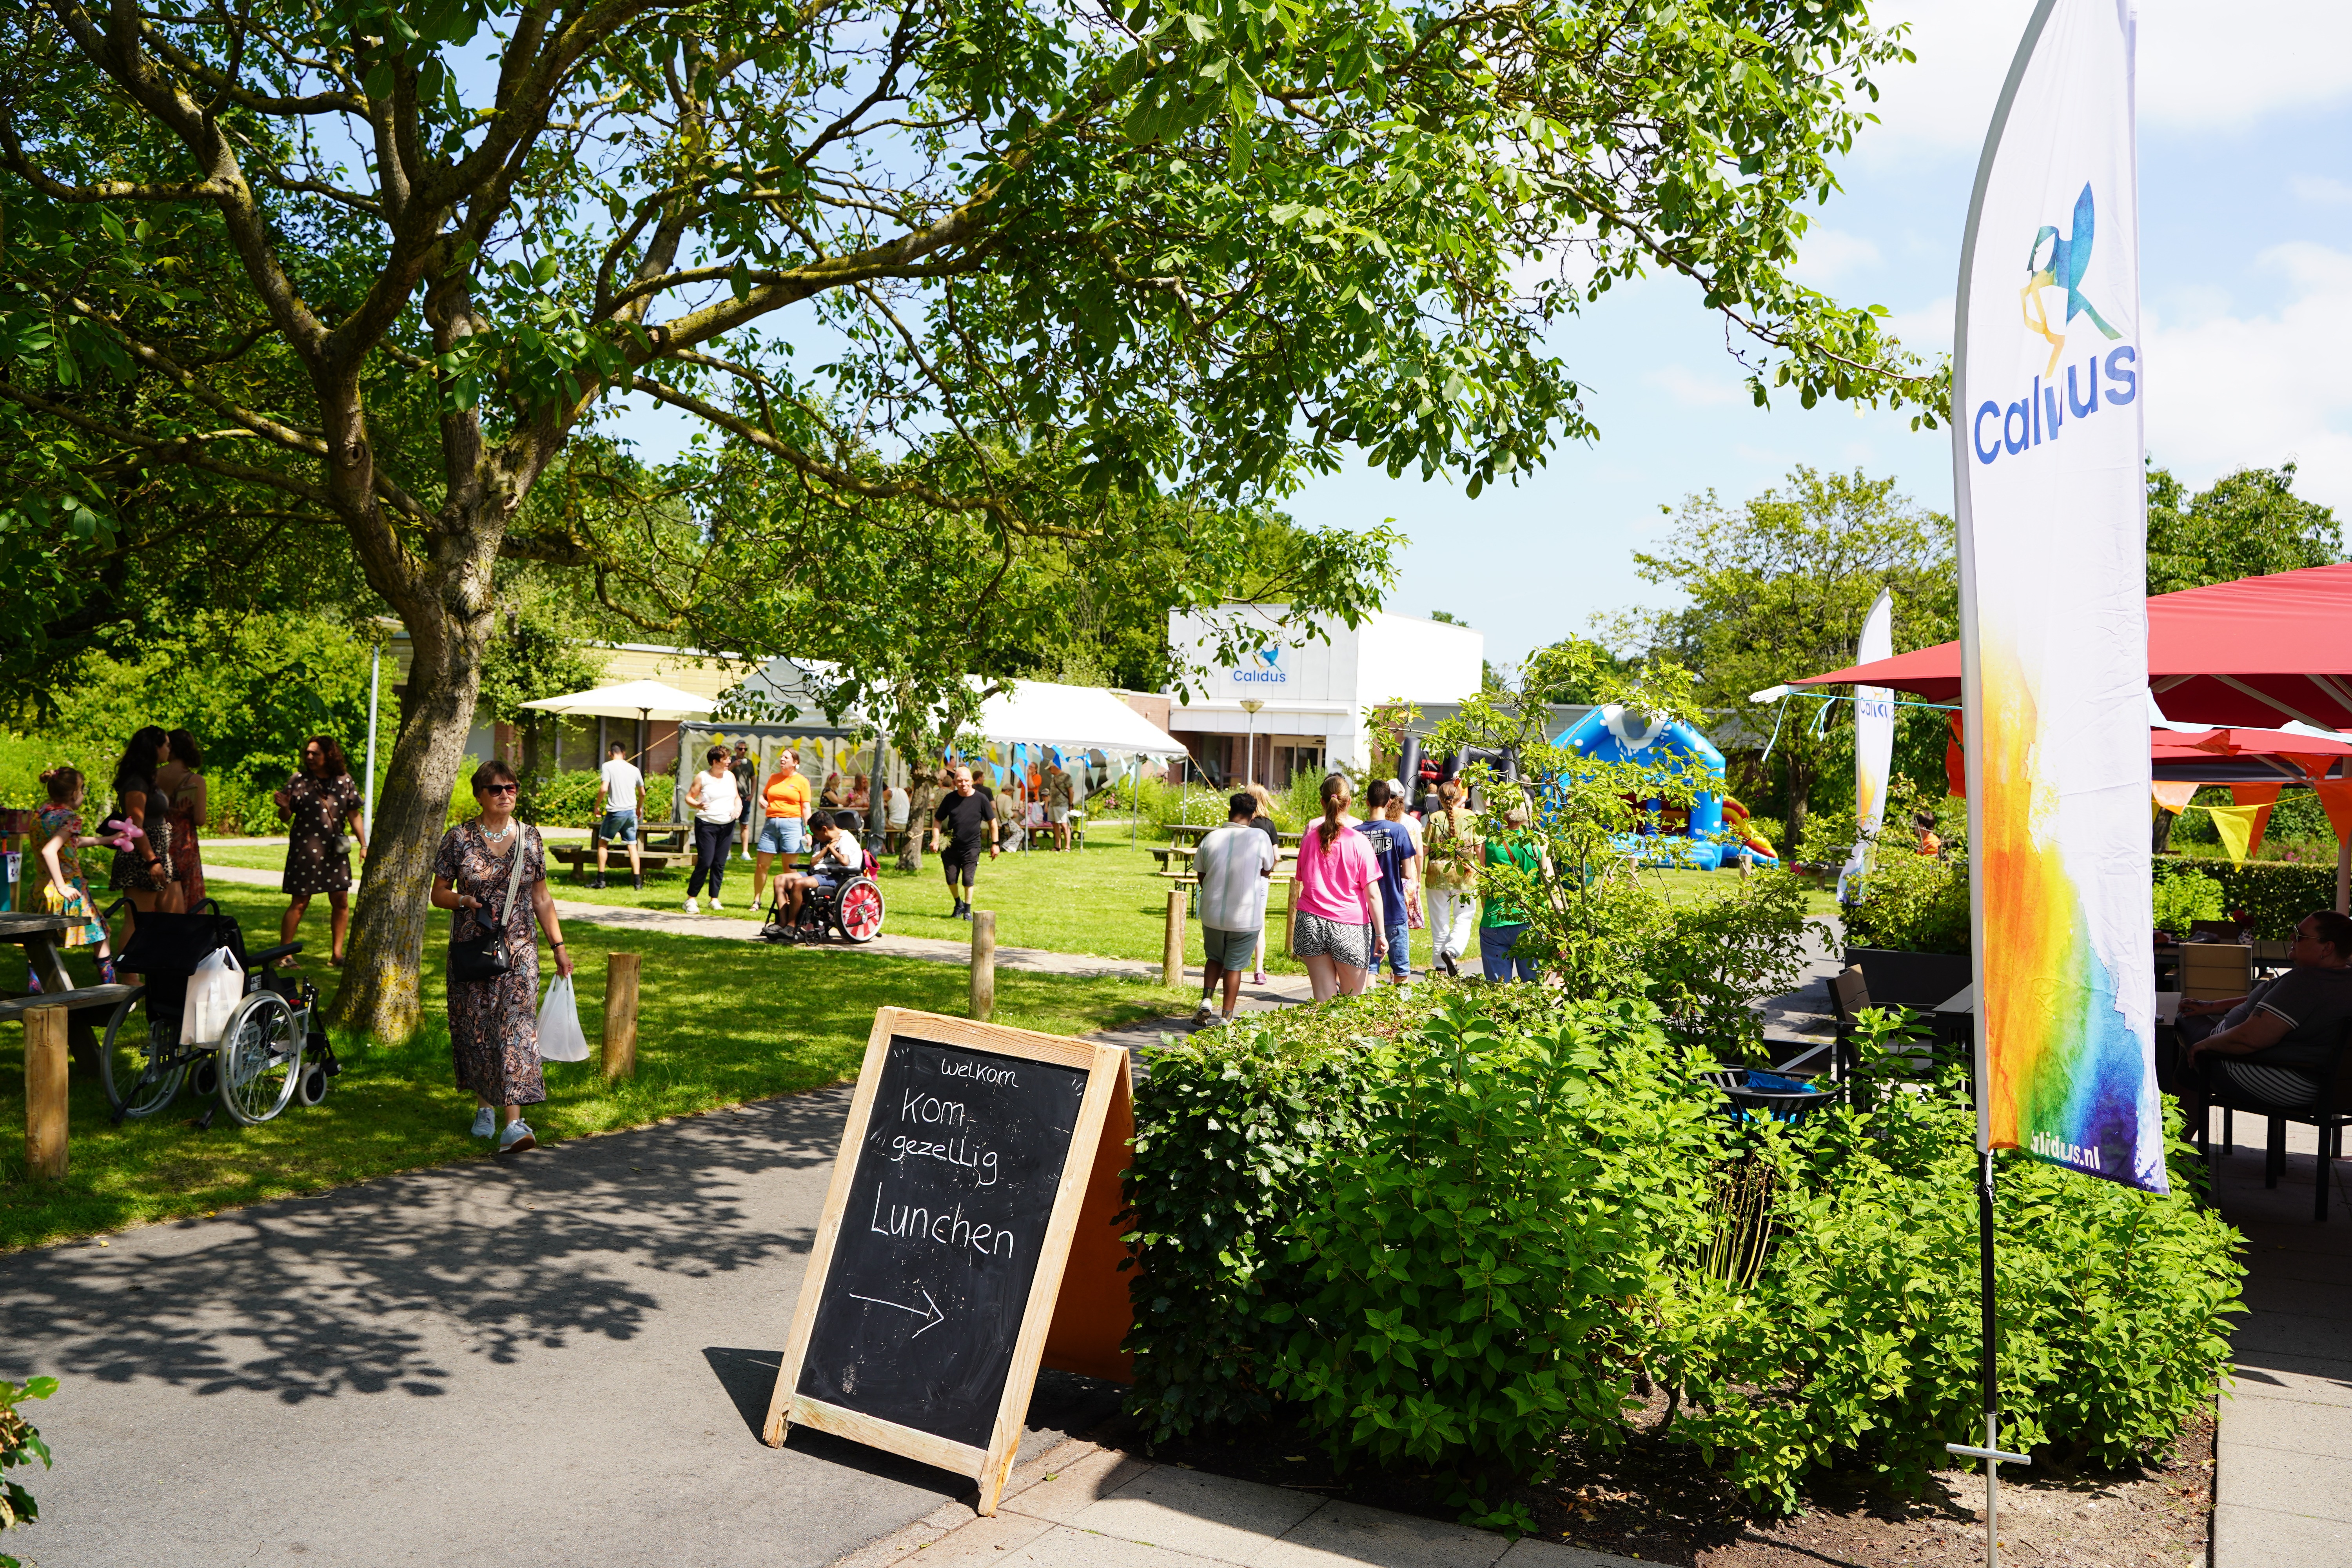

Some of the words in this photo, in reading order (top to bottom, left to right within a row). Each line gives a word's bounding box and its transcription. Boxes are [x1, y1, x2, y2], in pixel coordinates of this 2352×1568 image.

[1974, 345, 2136, 465] Calius
[1234, 670, 1286, 682] Calidus
[890, 1136, 998, 1185] gezellig
[2030, 1129, 2100, 1170] alidus.nl
[871, 1181, 1014, 1259] Lunchen
